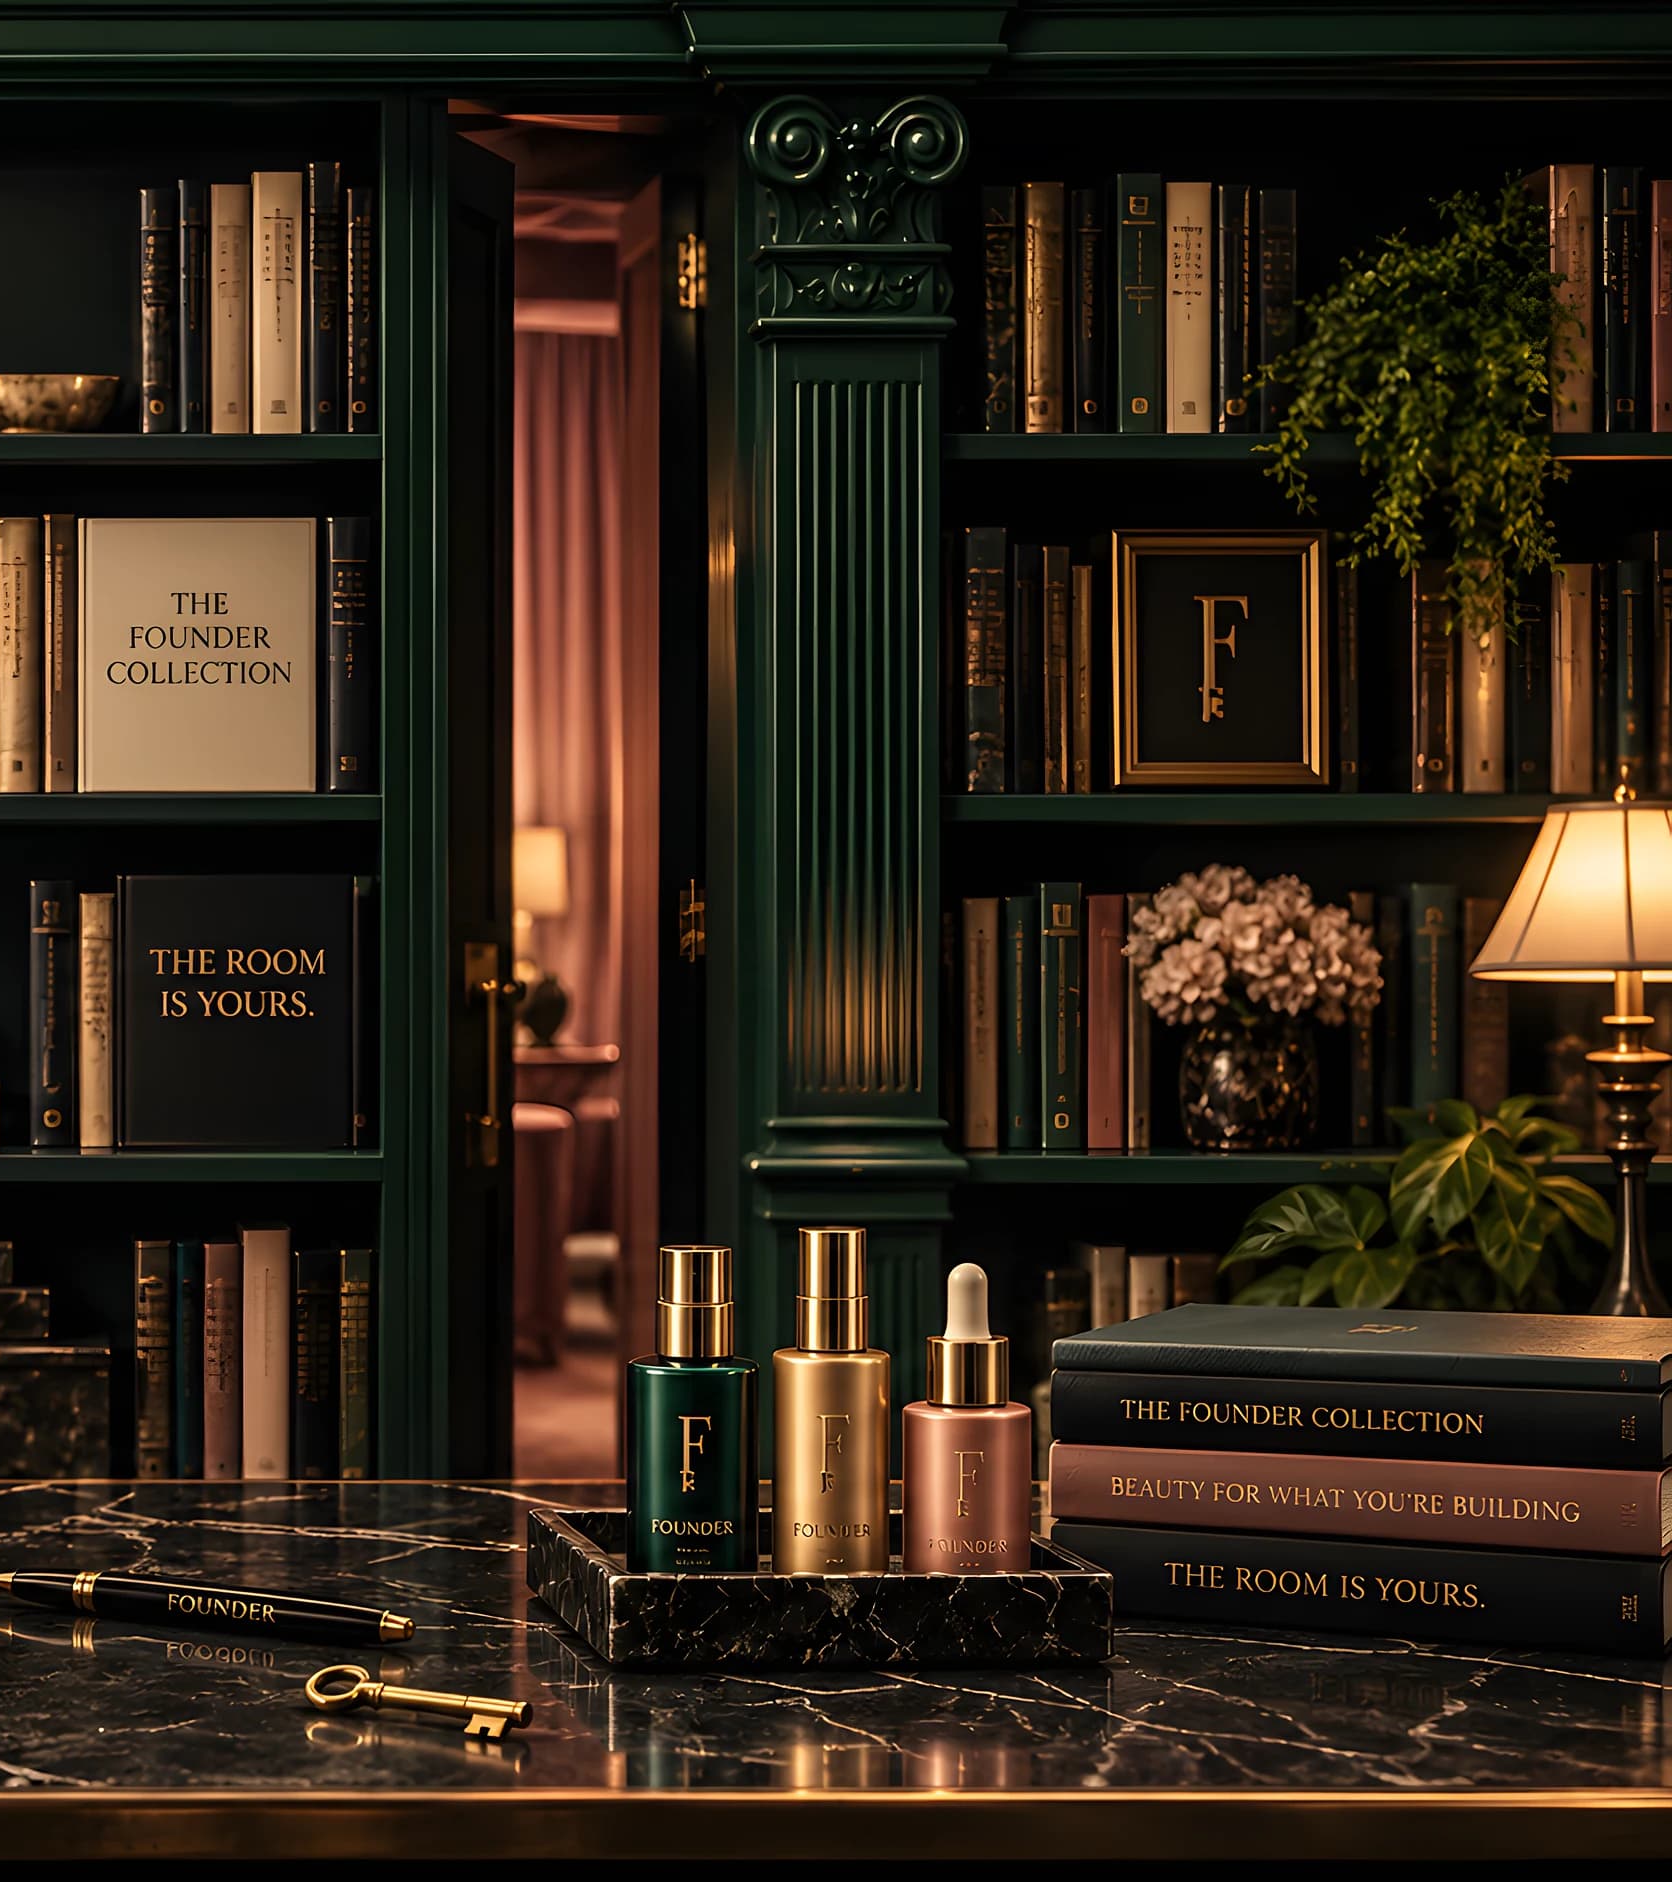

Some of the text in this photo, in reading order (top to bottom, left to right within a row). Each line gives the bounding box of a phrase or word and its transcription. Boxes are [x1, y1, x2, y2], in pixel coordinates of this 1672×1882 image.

[171, 593, 228, 614] THE
[130, 627, 270, 649] FOUNDER
[107, 662, 291, 684] COLLECTION
[150, 949, 325, 974] THE ROOM
[162, 991, 313, 1017] IS YOURS.
[1121, 1400, 1483, 1433] THE FOUNDER COLLECTION
[1112, 1477, 1579, 1522] BEAUTY FOR WHAT YOU'RE BUILDING
[651, 1518, 734, 1536] FOUNDER
[1164, 1563, 1485, 1607] THE ROOM IS YOURS.
[168, 1593, 276, 1623] FOUNDER
